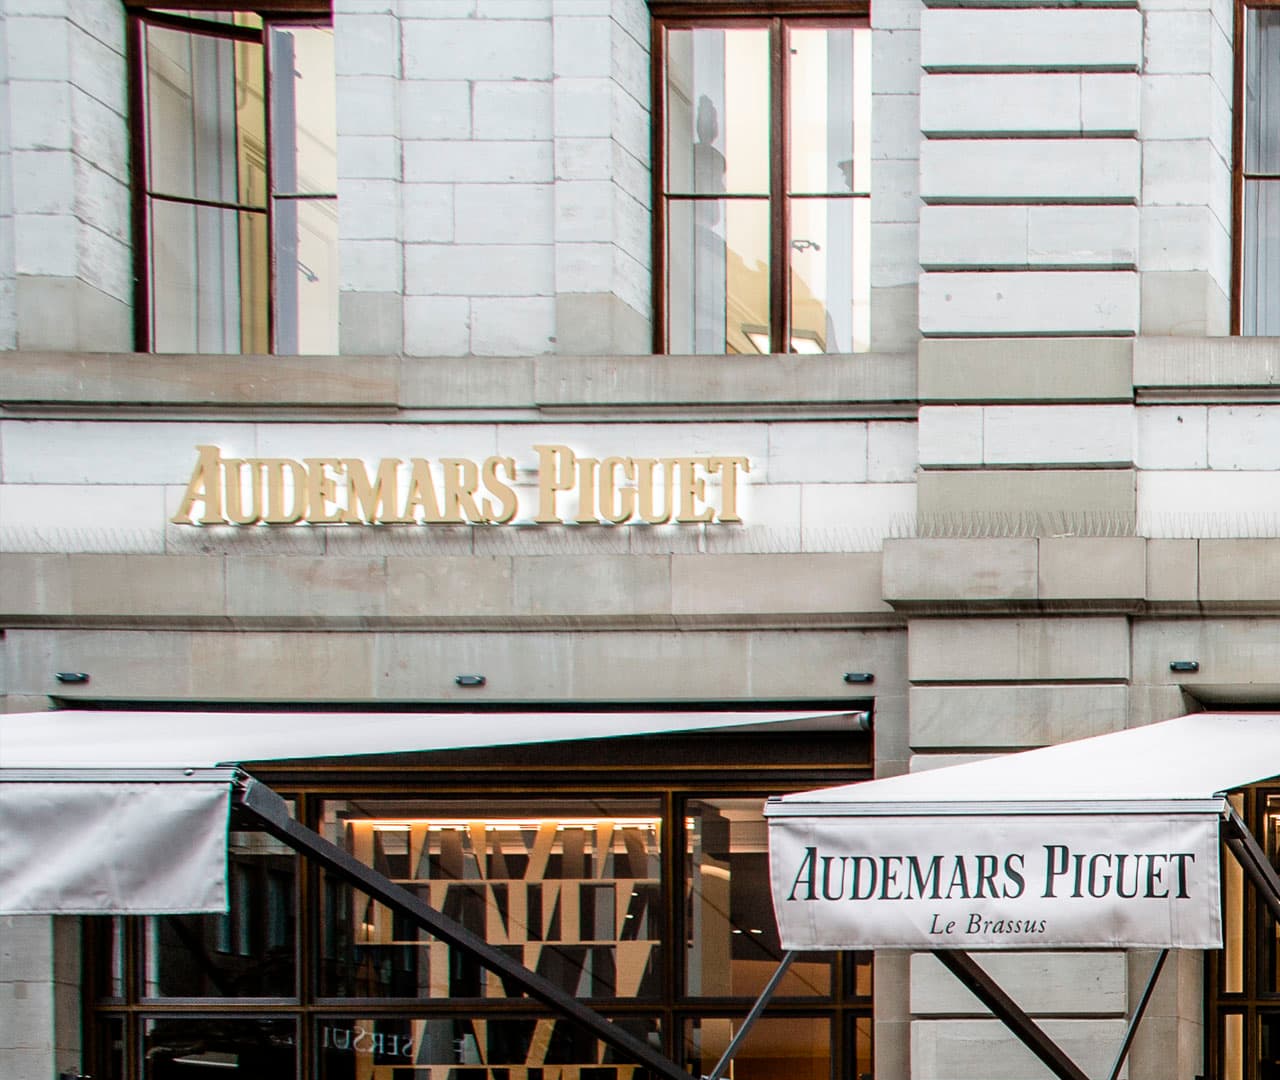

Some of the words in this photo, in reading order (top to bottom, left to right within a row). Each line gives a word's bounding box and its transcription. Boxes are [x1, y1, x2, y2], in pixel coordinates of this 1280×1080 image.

[170, 444, 516, 526] AUDEMARS
[532, 444, 750, 526] PIGUET
[787, 846, 1026, 901] AUDEMARS
[1042, 844, 1196, 899] PIGUET
[929, 913, 955, 935] Le
[966, 913, 1047, 935] Brassus
